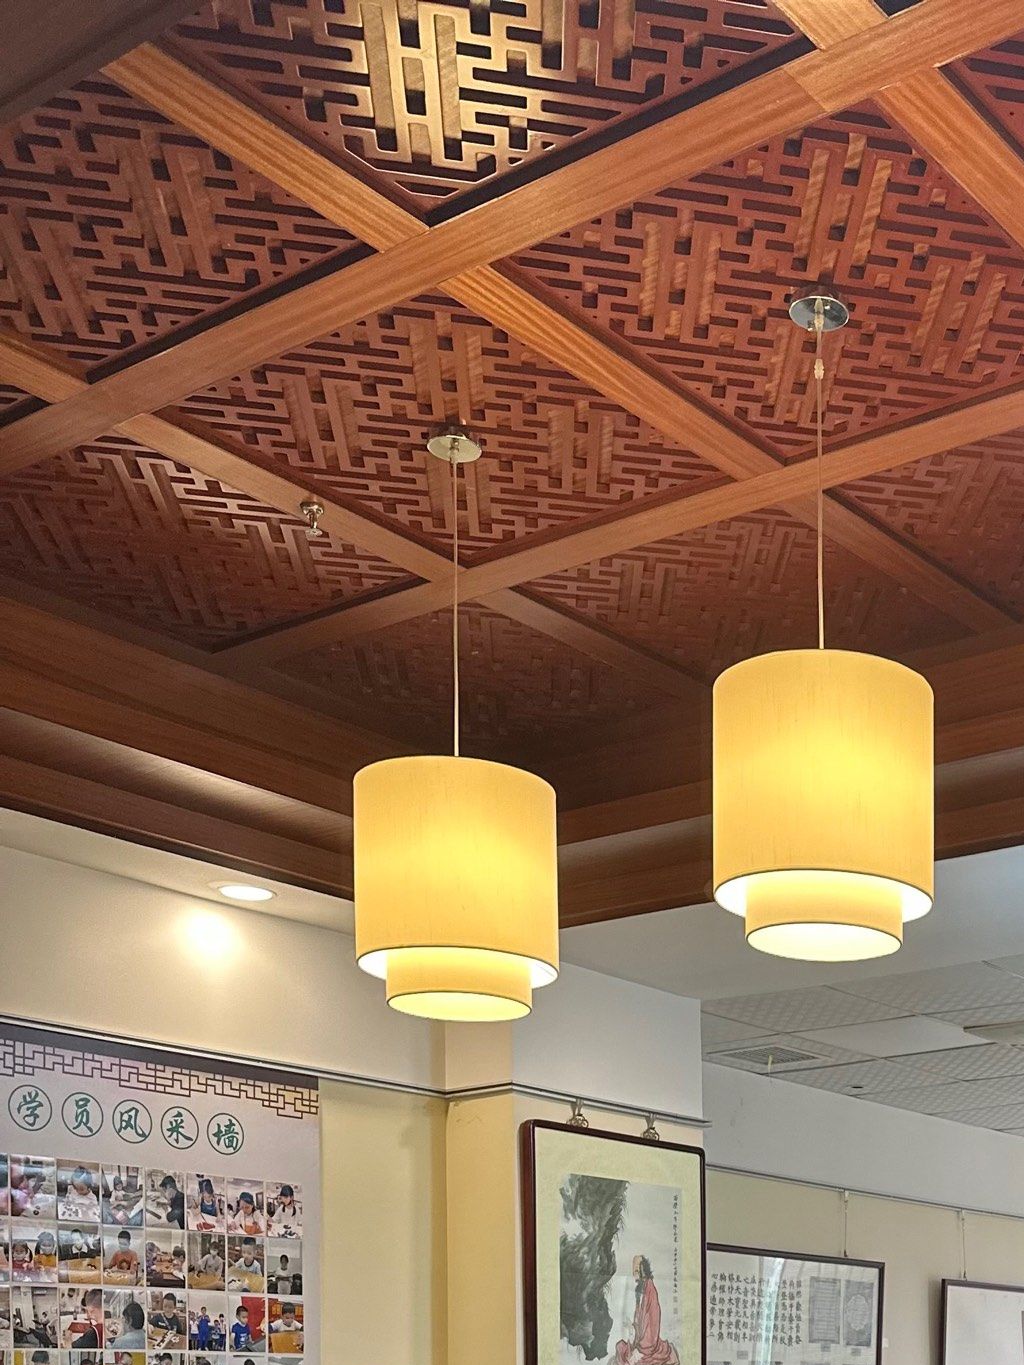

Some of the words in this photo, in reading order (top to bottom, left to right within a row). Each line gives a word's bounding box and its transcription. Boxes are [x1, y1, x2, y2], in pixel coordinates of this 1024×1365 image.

[16, 1089, 239, 1151] 学员风采墙
